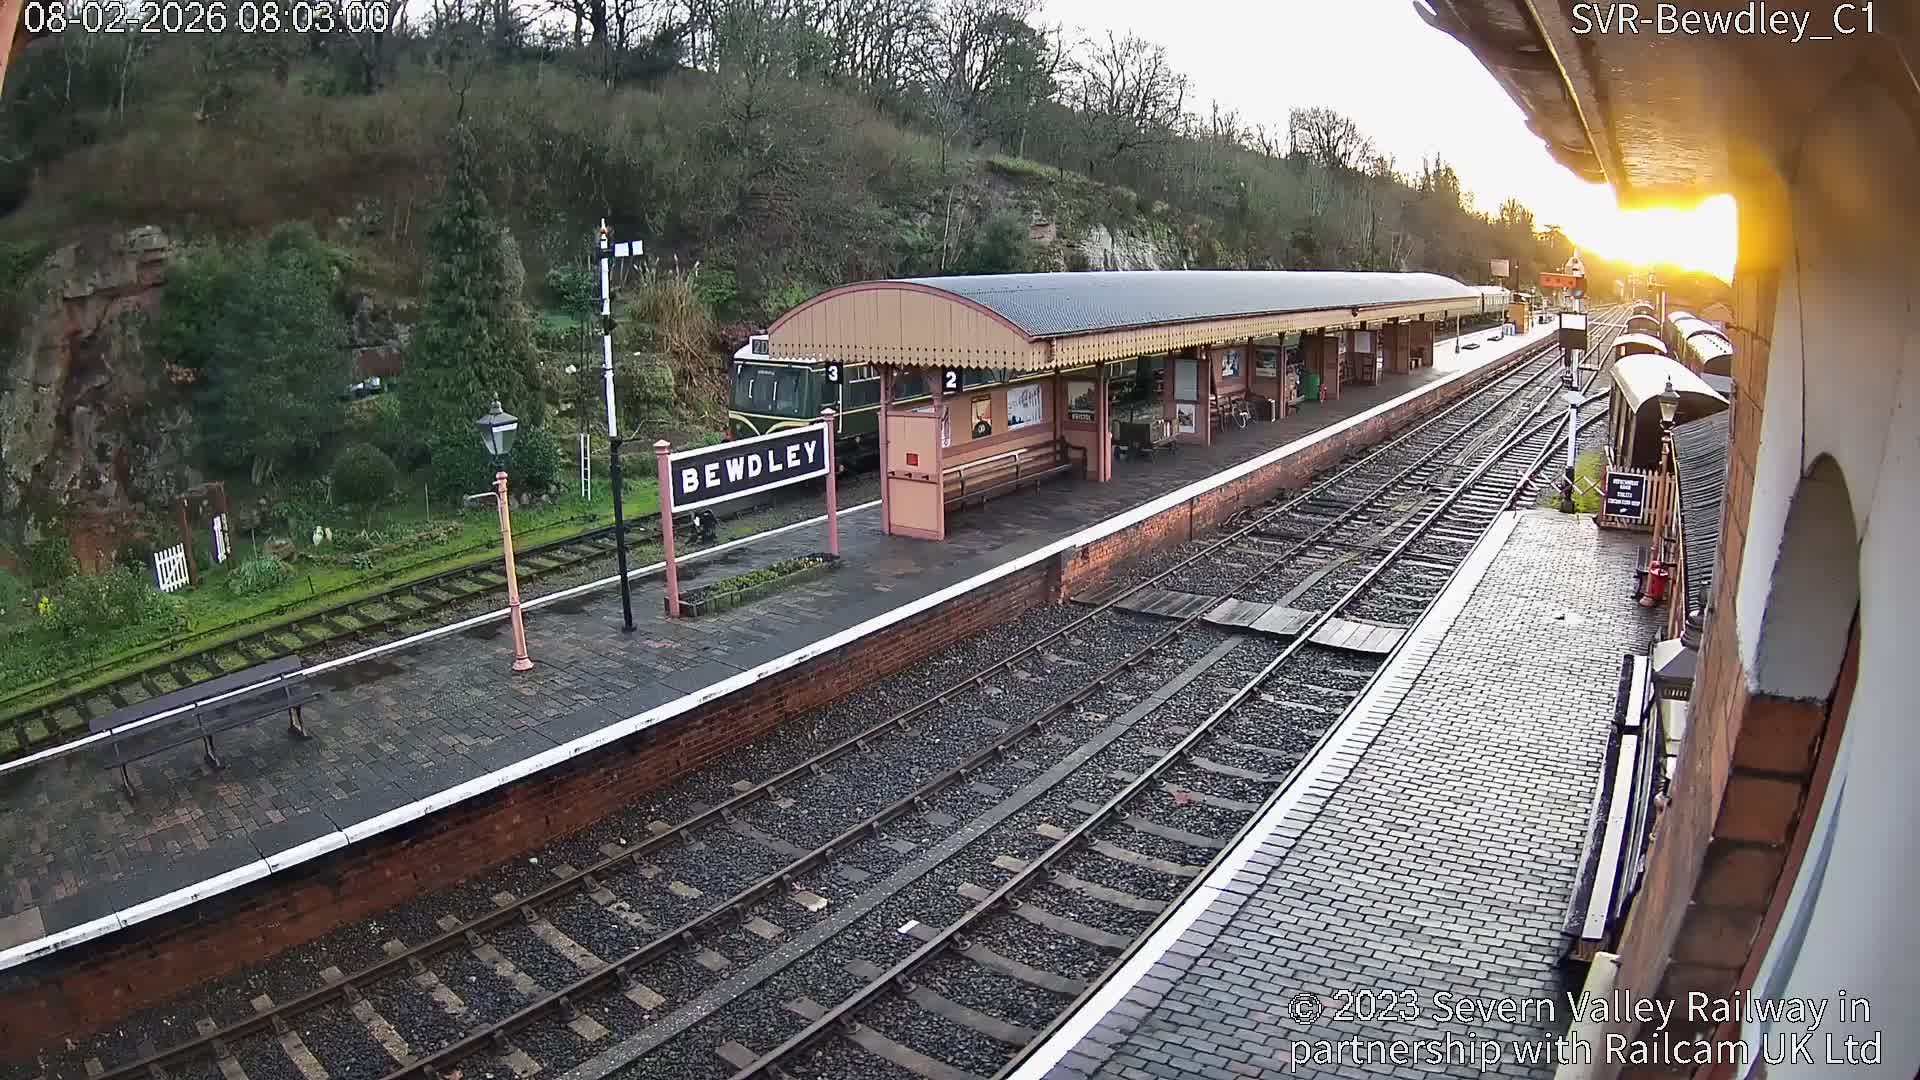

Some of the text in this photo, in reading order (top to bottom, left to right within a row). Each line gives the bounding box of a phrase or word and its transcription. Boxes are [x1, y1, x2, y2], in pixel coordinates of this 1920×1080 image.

[828, 365, 838, 381] 3
[946, 371, 957, 388] 2
[681, 440, 817, 494] BEWDLEY
